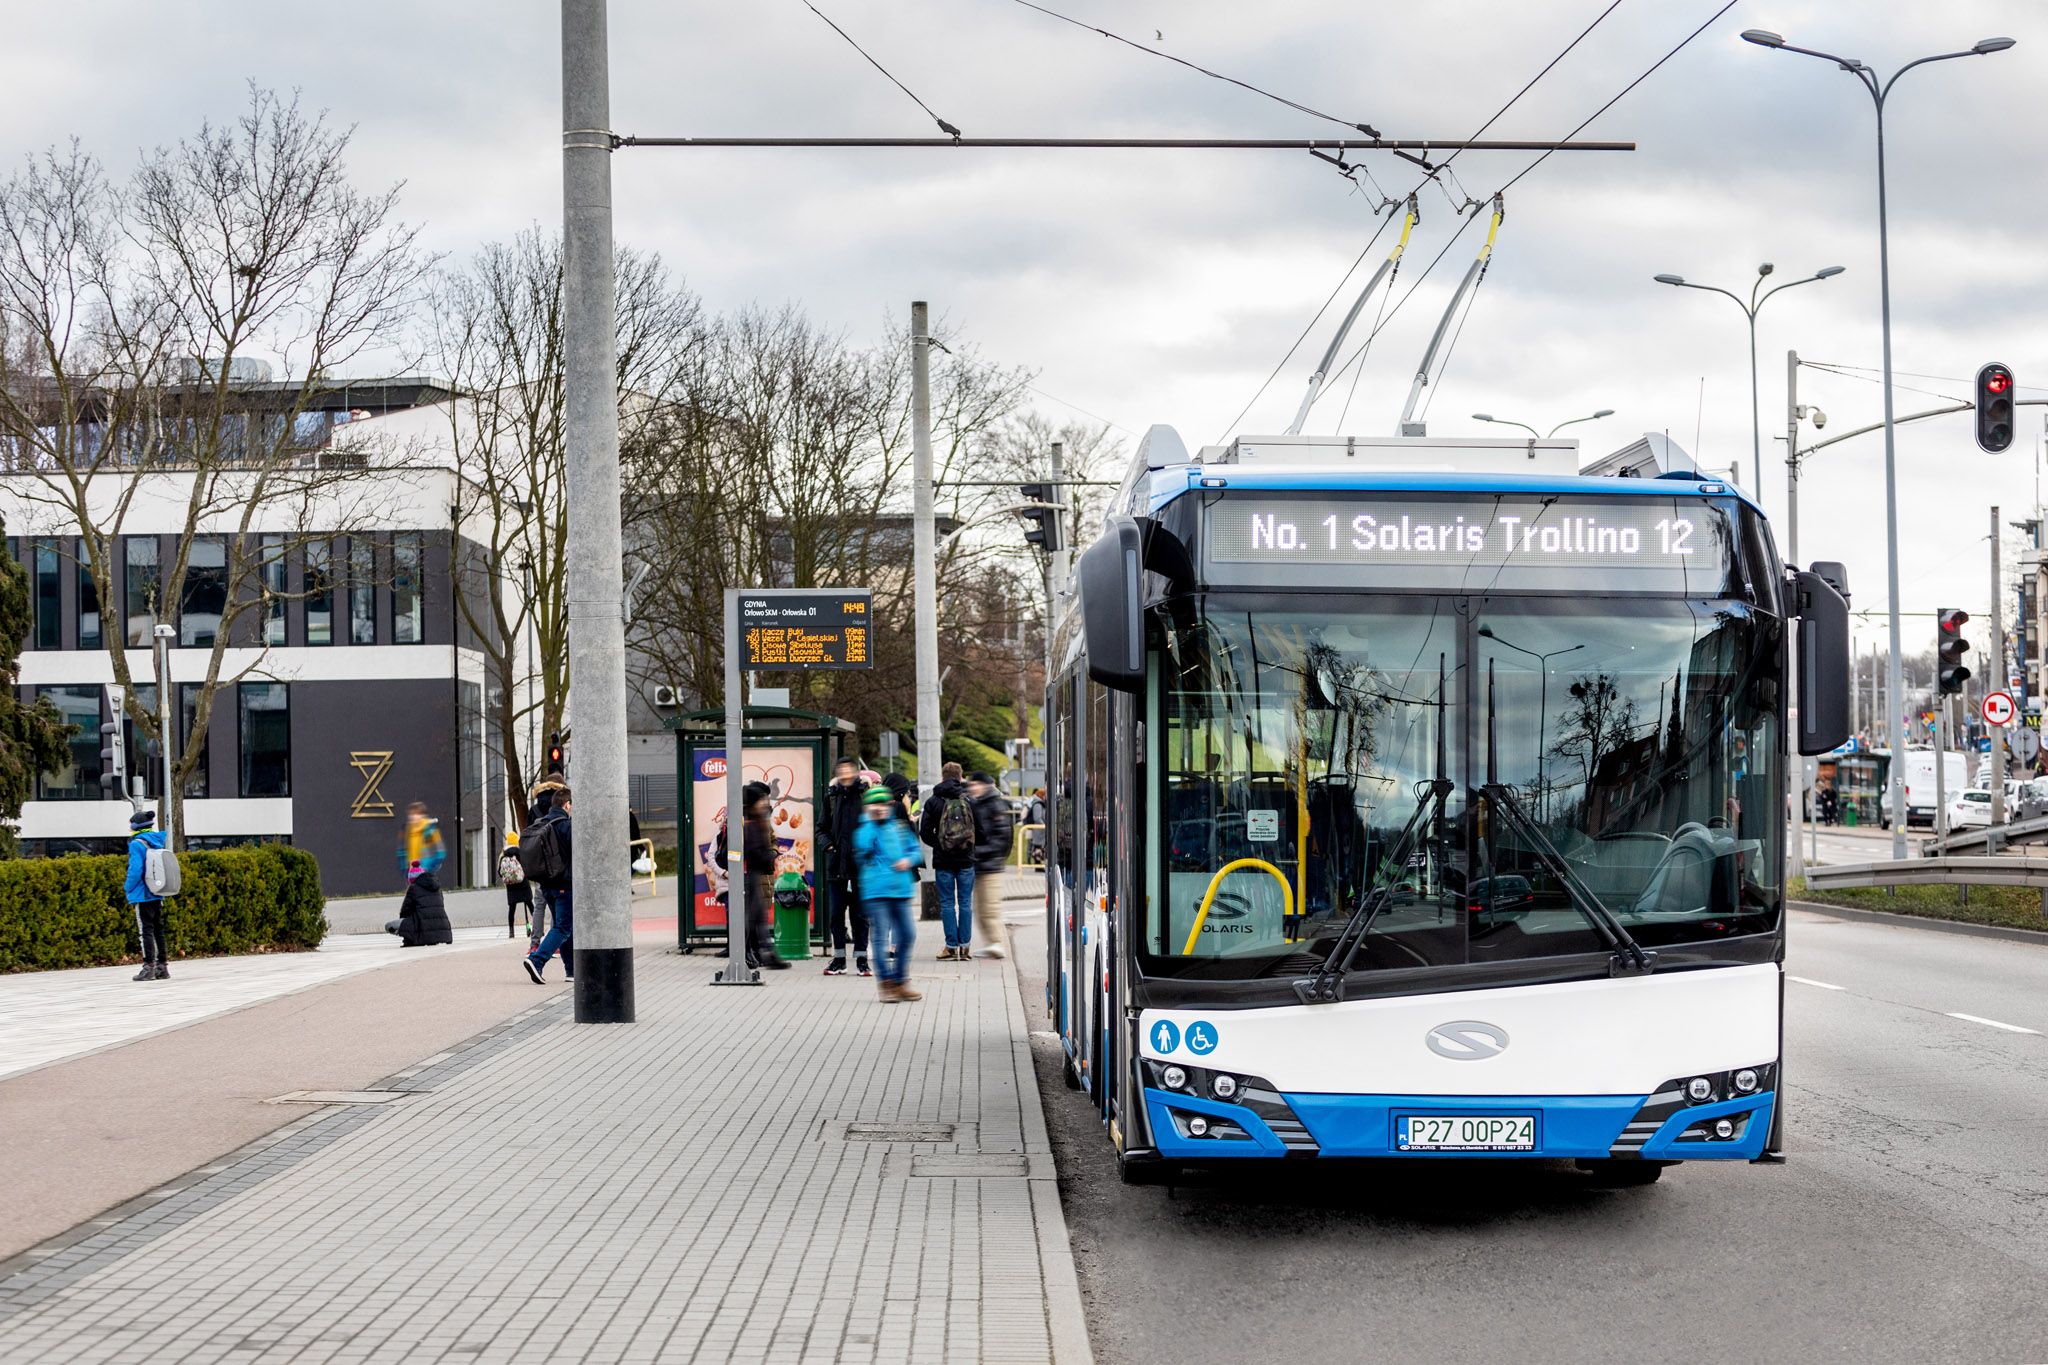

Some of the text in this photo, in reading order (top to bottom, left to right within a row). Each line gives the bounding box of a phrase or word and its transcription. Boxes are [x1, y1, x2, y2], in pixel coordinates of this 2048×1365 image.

[1252, 513, 1694, 554] No. 1 Solaris Trollino 12
[808, 607, 817, 616] 01
[843, 602, 865, 613] 14:49
[761, 628, 785, 636] Kacze
[762, 641, 787, 649] Cisowa
[761, 655, 787, 663] Gdynia
[1200, 924, 1253, 934] OLARIS
[1412, 1120, 1531, 1143] P27 00P24
